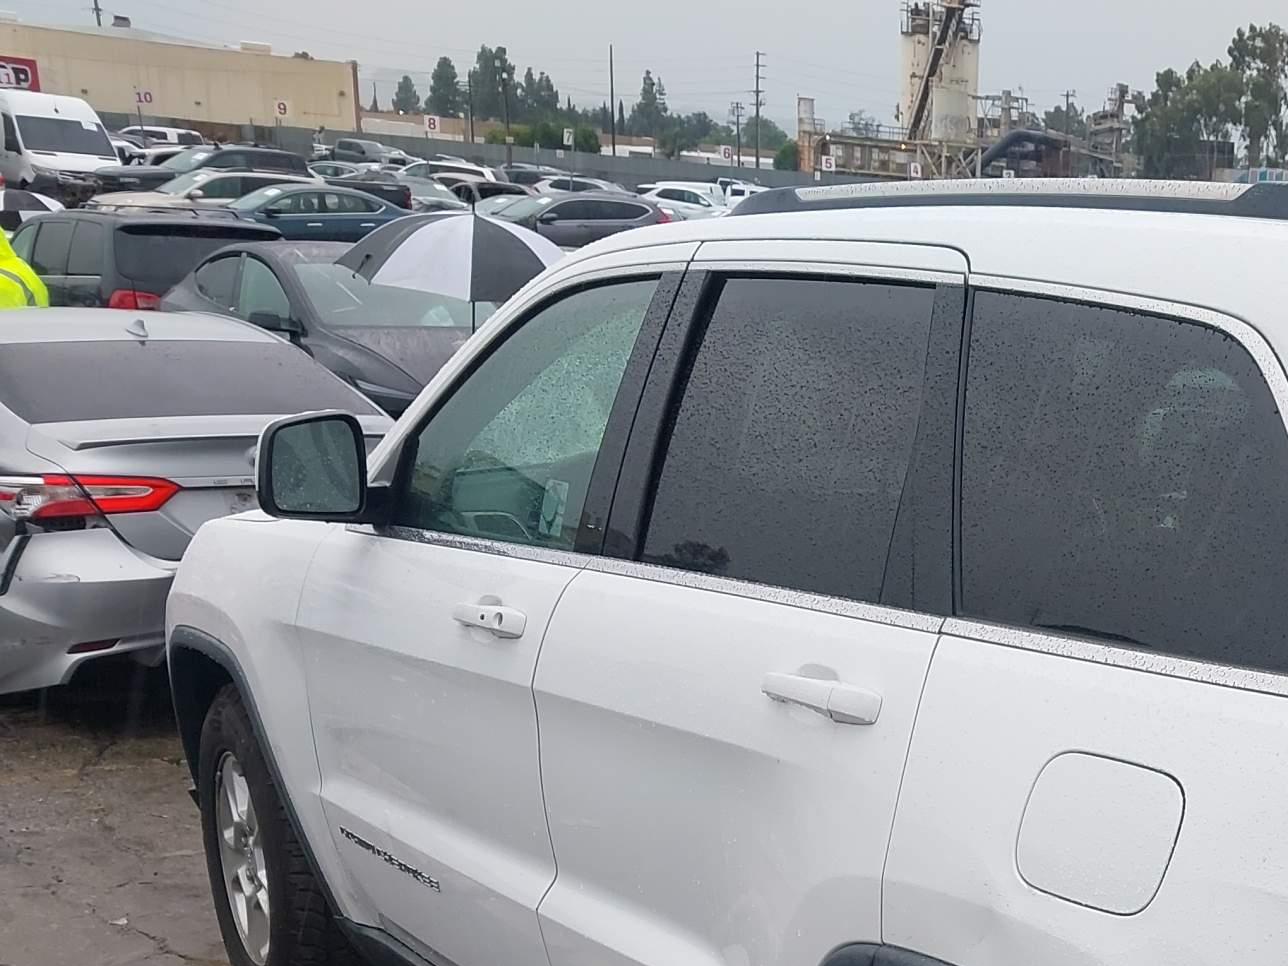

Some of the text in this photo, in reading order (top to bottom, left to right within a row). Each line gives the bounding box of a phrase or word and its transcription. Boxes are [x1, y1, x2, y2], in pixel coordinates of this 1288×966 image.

[135, 91, 153, 104] 10
[277, 102, 287, 116] 9
[427, 117, 436, 130] 8
[565, 130, 573, 143] 7
[723, 147, 731, 159] 6
[825, 158, 833, 169] 5
[912, 164, 919, 175] 4
